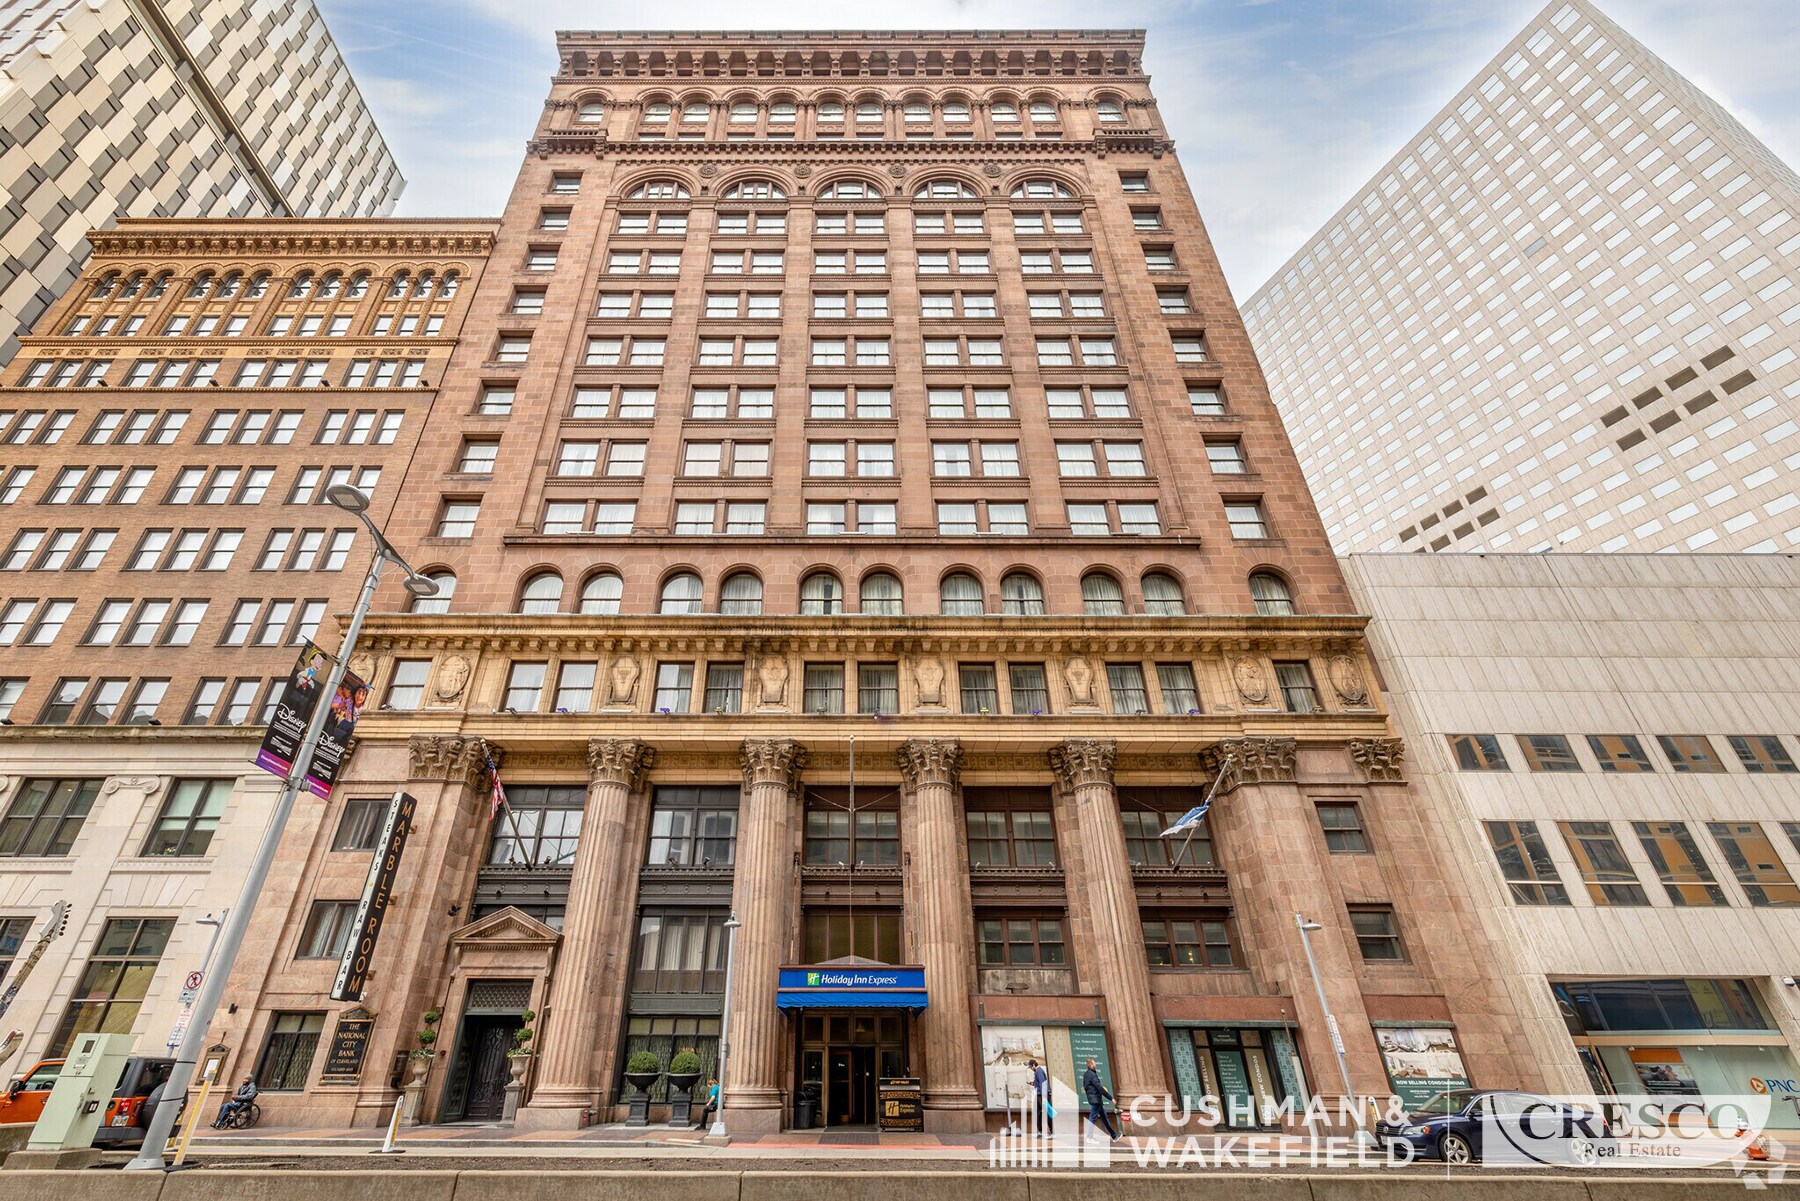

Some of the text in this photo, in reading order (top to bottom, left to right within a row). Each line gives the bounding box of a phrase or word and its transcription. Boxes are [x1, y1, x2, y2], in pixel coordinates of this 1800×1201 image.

[277, 702, 306, 733] Disney
[374, 800, 398, 871] STEAKS
[348, 801, 412, 993] MARBLE ROOM
[336, 900, 368, 990] RAW BAR
[821, 974, 853, 986] Holiday
[854, 974, 867, 984] Inn
[868, 975, 897, 986] Express
[1253, 1056, 1262, 1083] CONDOS
[1766, 1080, 1800, 1092] PNC
